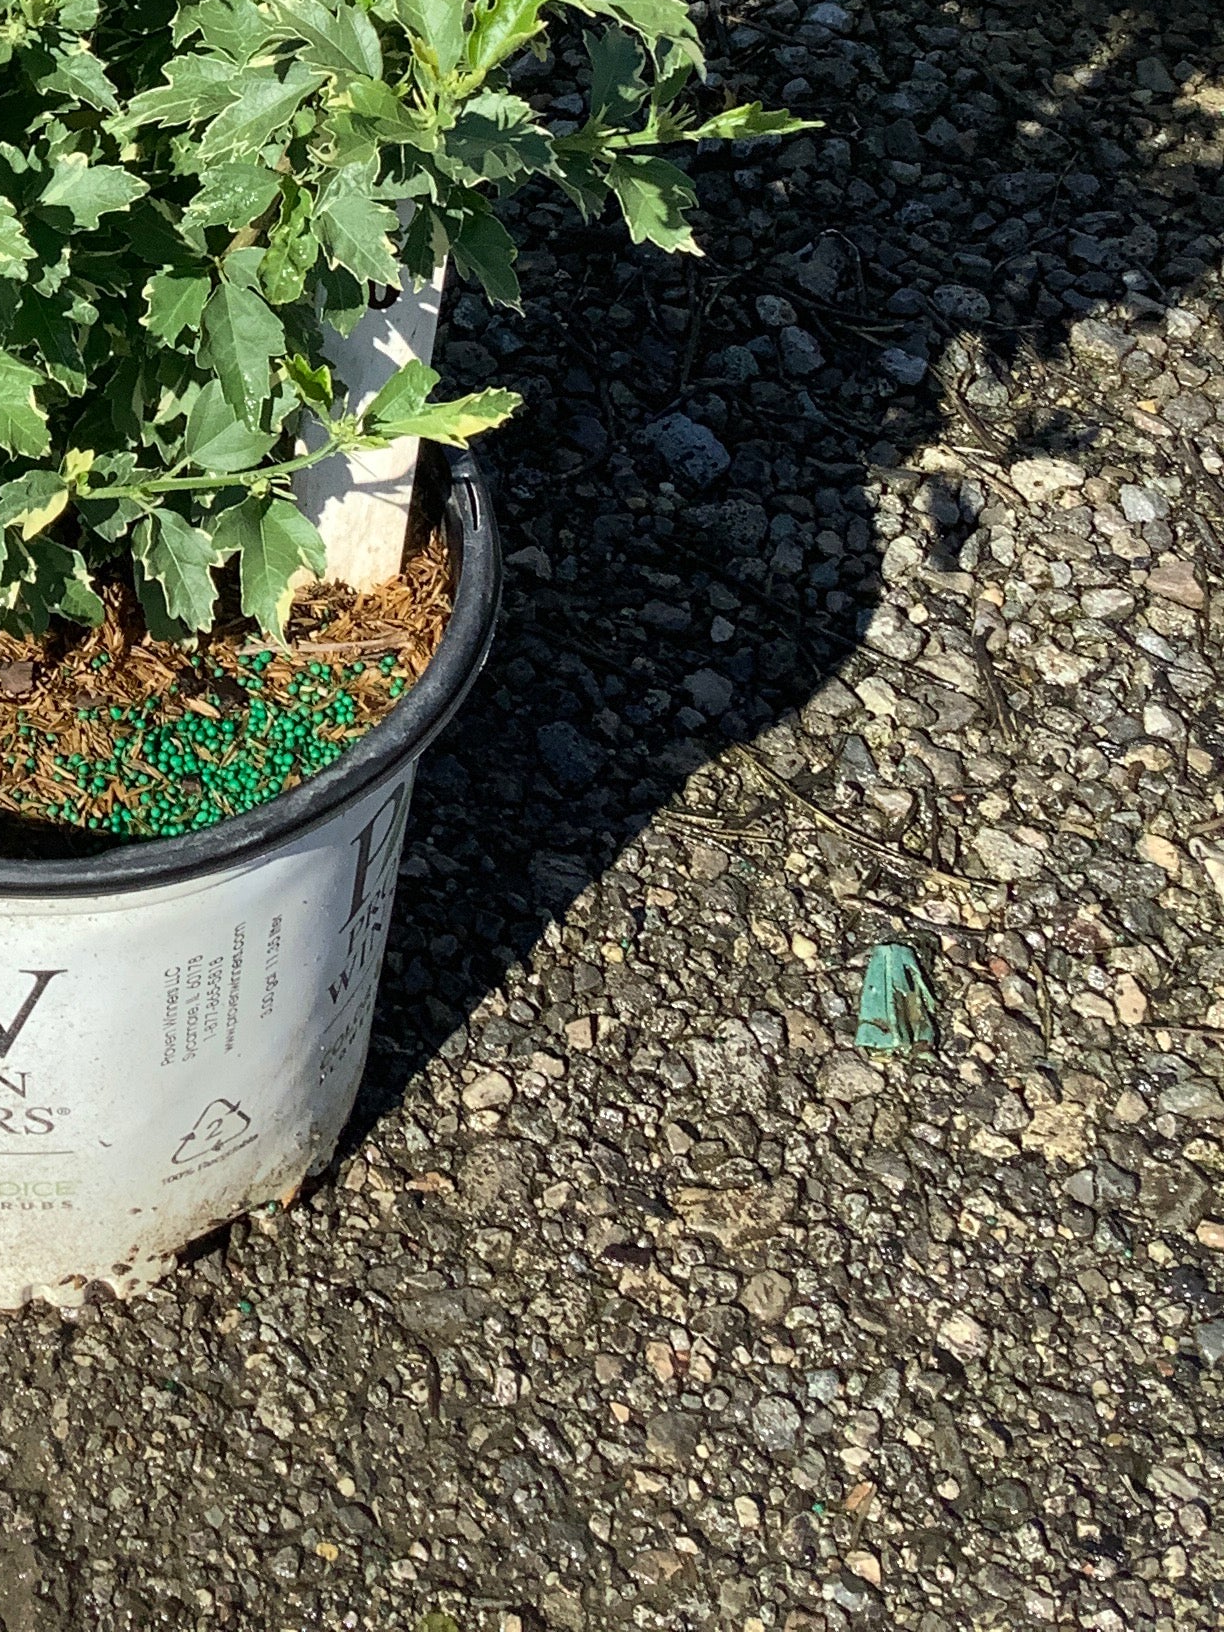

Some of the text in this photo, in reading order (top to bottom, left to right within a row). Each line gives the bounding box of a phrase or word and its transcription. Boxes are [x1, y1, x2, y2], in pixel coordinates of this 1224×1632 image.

[186, 954, 204, 989] 60178
[160, 966, 181, 1067] Proven Winners LLC
[204, 1117, 224, 1142] 2
